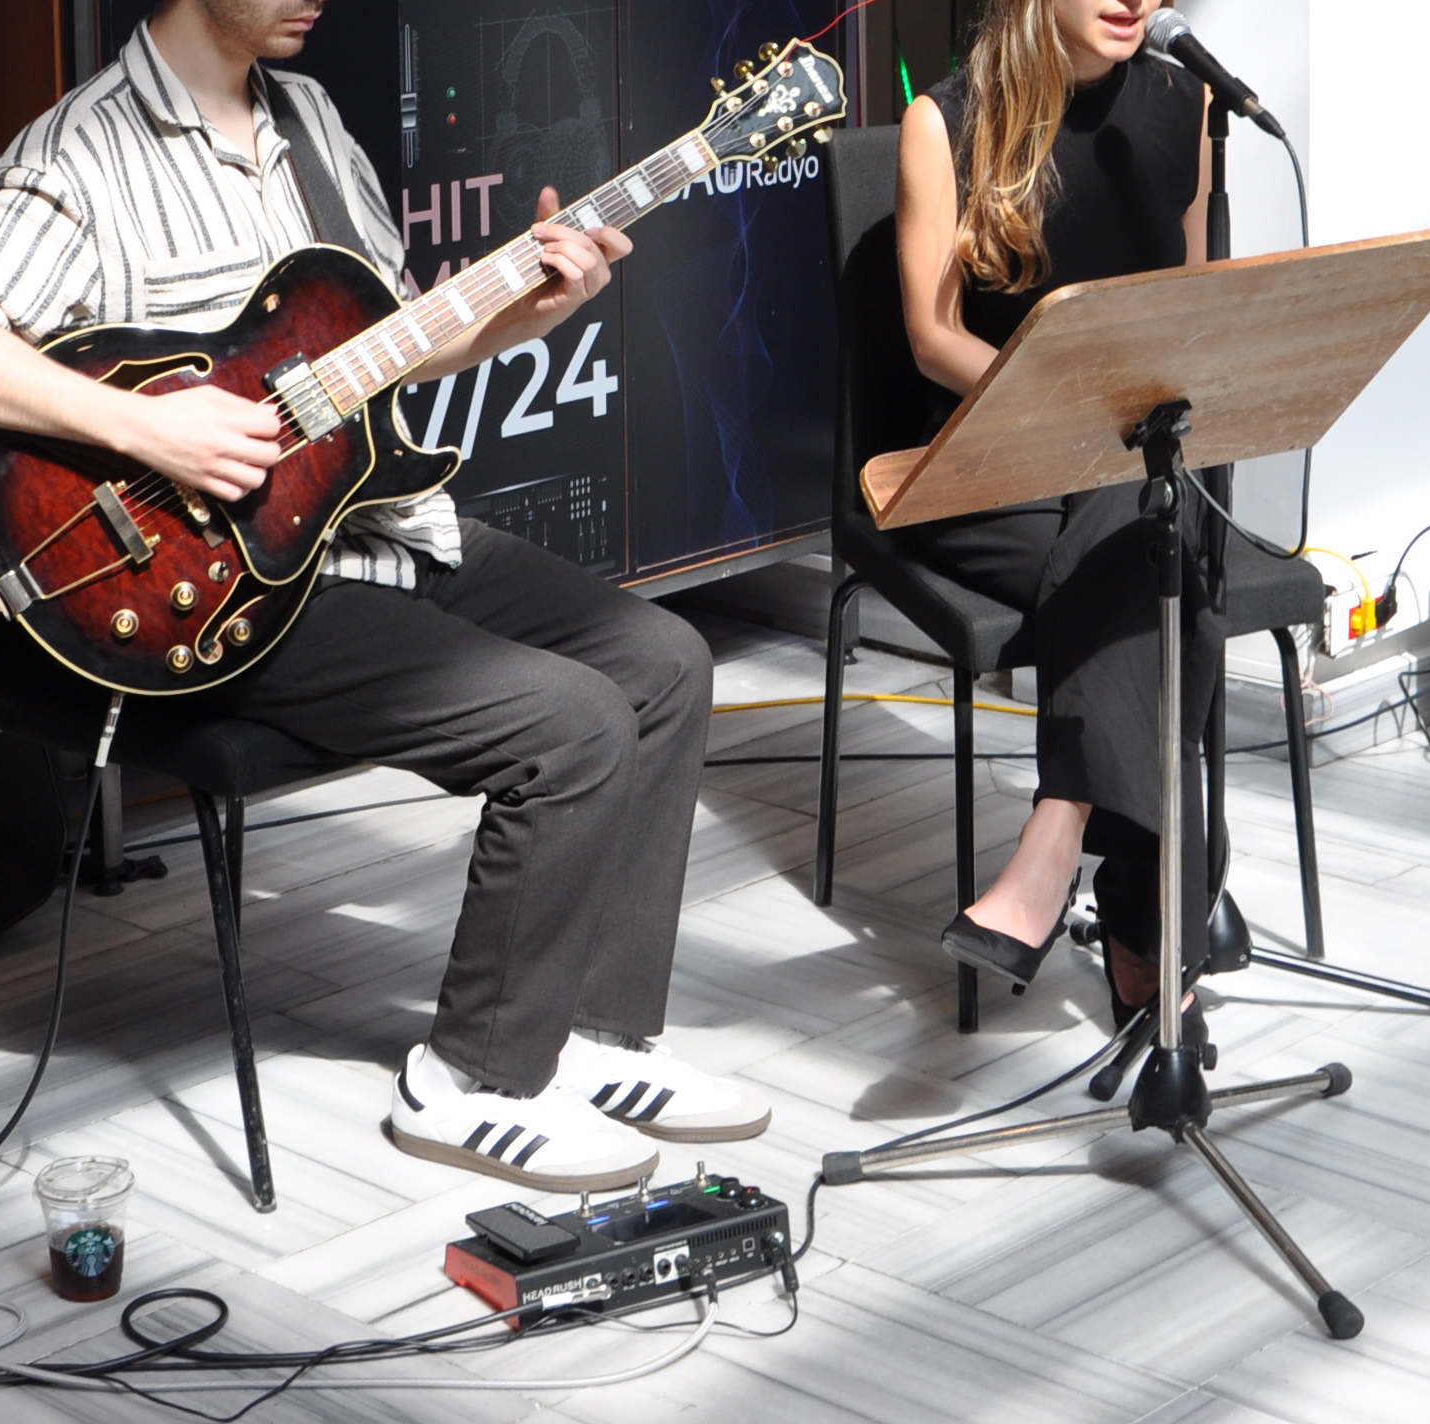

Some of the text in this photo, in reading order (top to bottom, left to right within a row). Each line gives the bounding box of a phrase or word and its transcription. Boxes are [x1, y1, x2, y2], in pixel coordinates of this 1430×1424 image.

[798, 54, 835, 104] Ibanez
[403, 174, 503, 250] HIT
[522, 1278, 584, 1304] HEADRUSH
